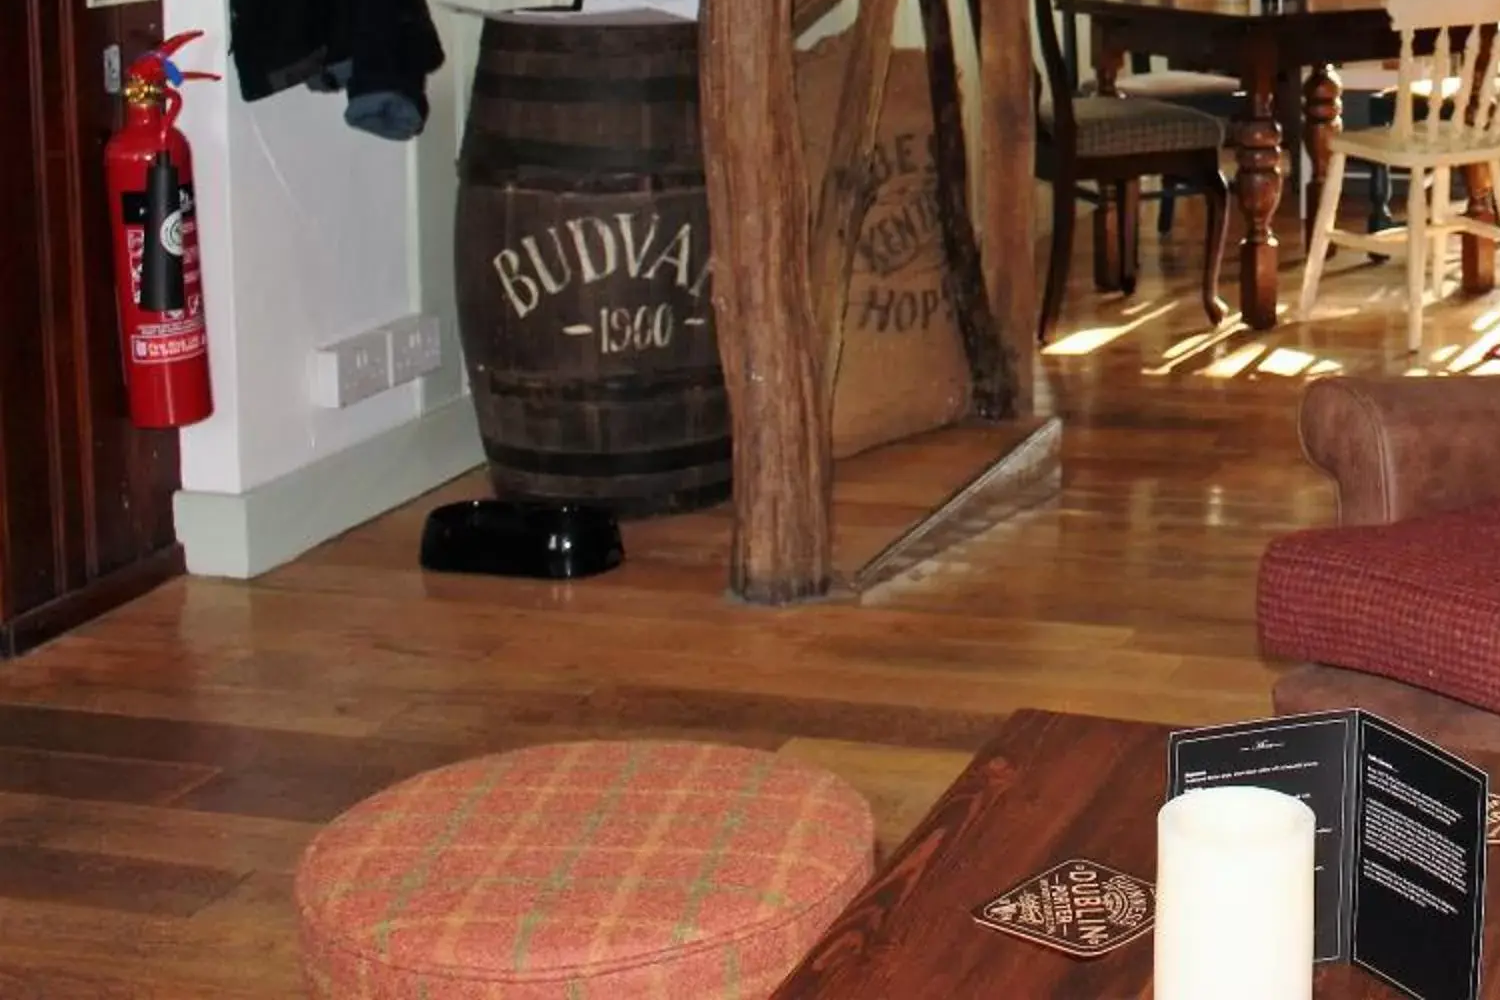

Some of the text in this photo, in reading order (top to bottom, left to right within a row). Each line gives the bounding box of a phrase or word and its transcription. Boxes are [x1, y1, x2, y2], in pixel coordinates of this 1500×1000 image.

[492, 212, 714, 319] BUDVA
[1050, 884, 1073, 924] PORTER
[1068, 870, 1108, 940] DUBLIN
